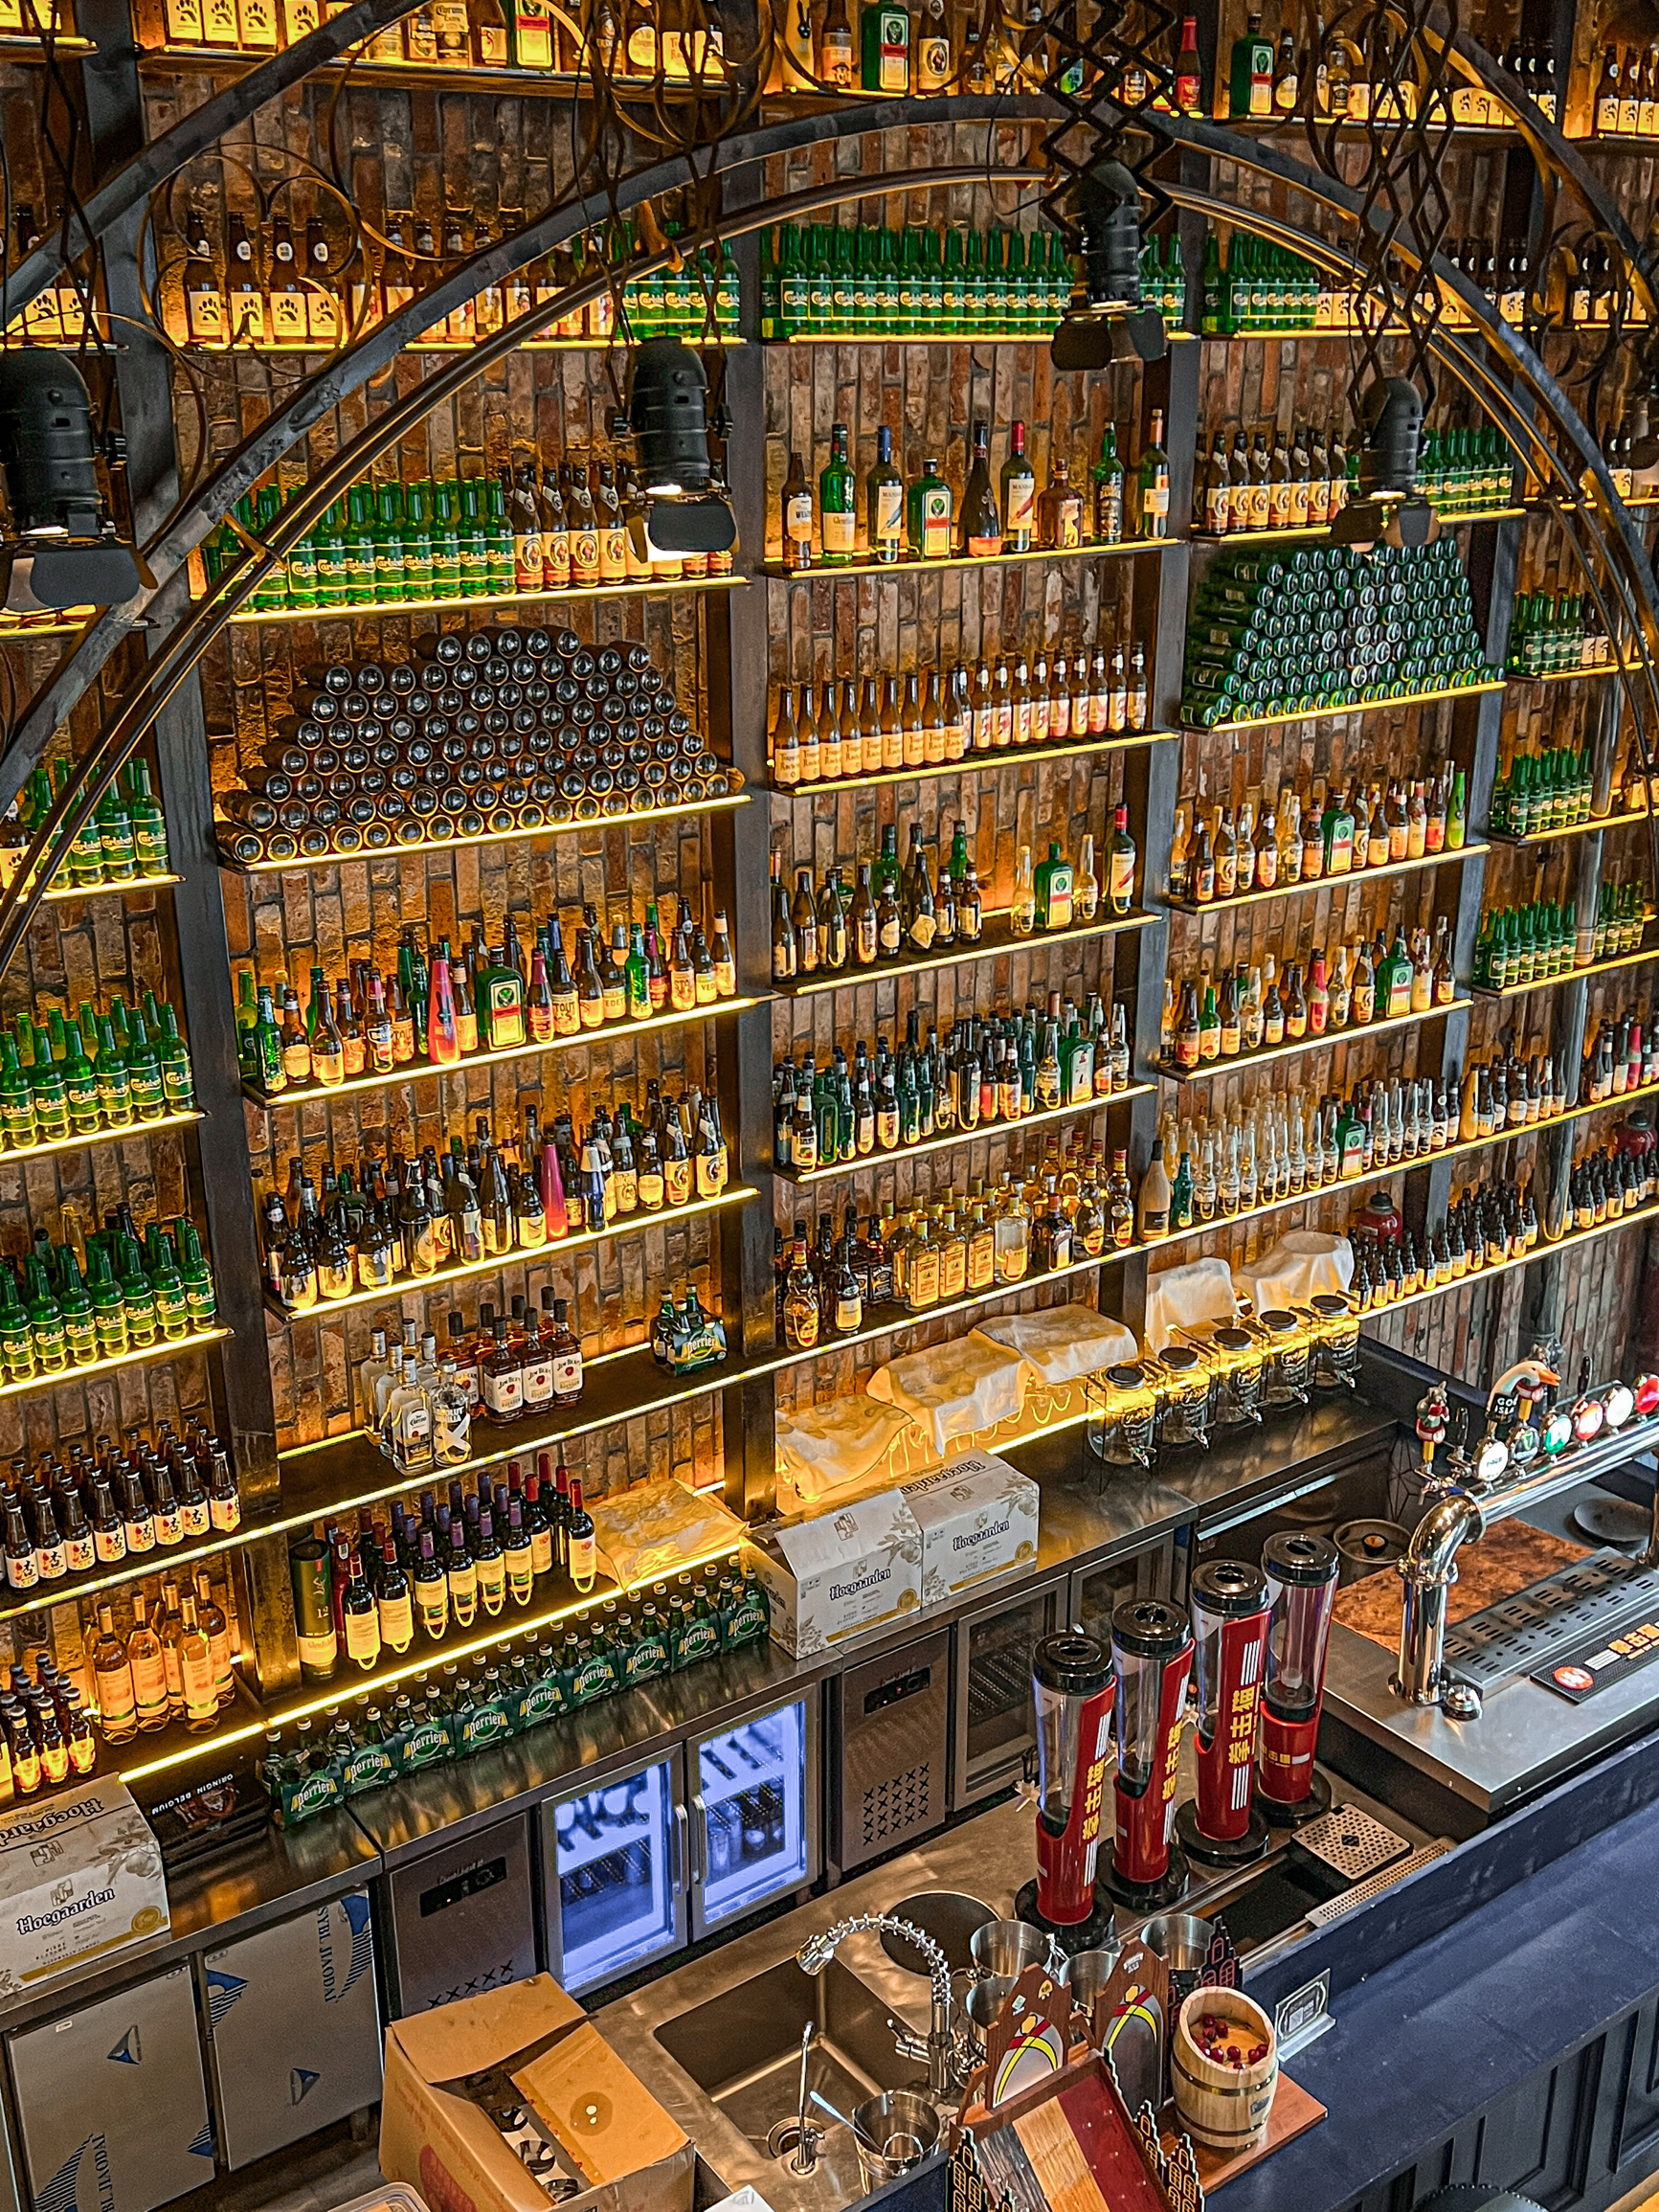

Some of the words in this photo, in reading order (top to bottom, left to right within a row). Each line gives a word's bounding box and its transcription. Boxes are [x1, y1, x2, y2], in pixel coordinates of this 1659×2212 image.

[685, 1333, 717, 1355] perrier
[953, 1519, 1010, 1551] Hoegaarden
[829, 1568, 891, 1600] Hoegaarden
[317, 1606, 329, 1619] 12
[733, 1610, 761, 1636] perrier
[682, 1627, 711, 1655] perrier
[629, 1644, 661, 1671] perrier
[578, 1663, 609, 1690] perrier
[523, 1686, 557, 1714] perrier
[467, 1711, 502, 1739] perrier
[1228, 1684, 1258, 1765] 拳击猫
[408, 1731, 443, 1758] perrier
[349, 1754, 385, 1782] perrier
[150, 1792, 192, 1816] BELGIUM
[297, 1779, 331, 1813] perrier
[16, 1887, 116, 1935] Hoegaarden
[319, 1946, 338, 2003] JIAODAI
[92, 2132, 113, 2193] JIAODAI
